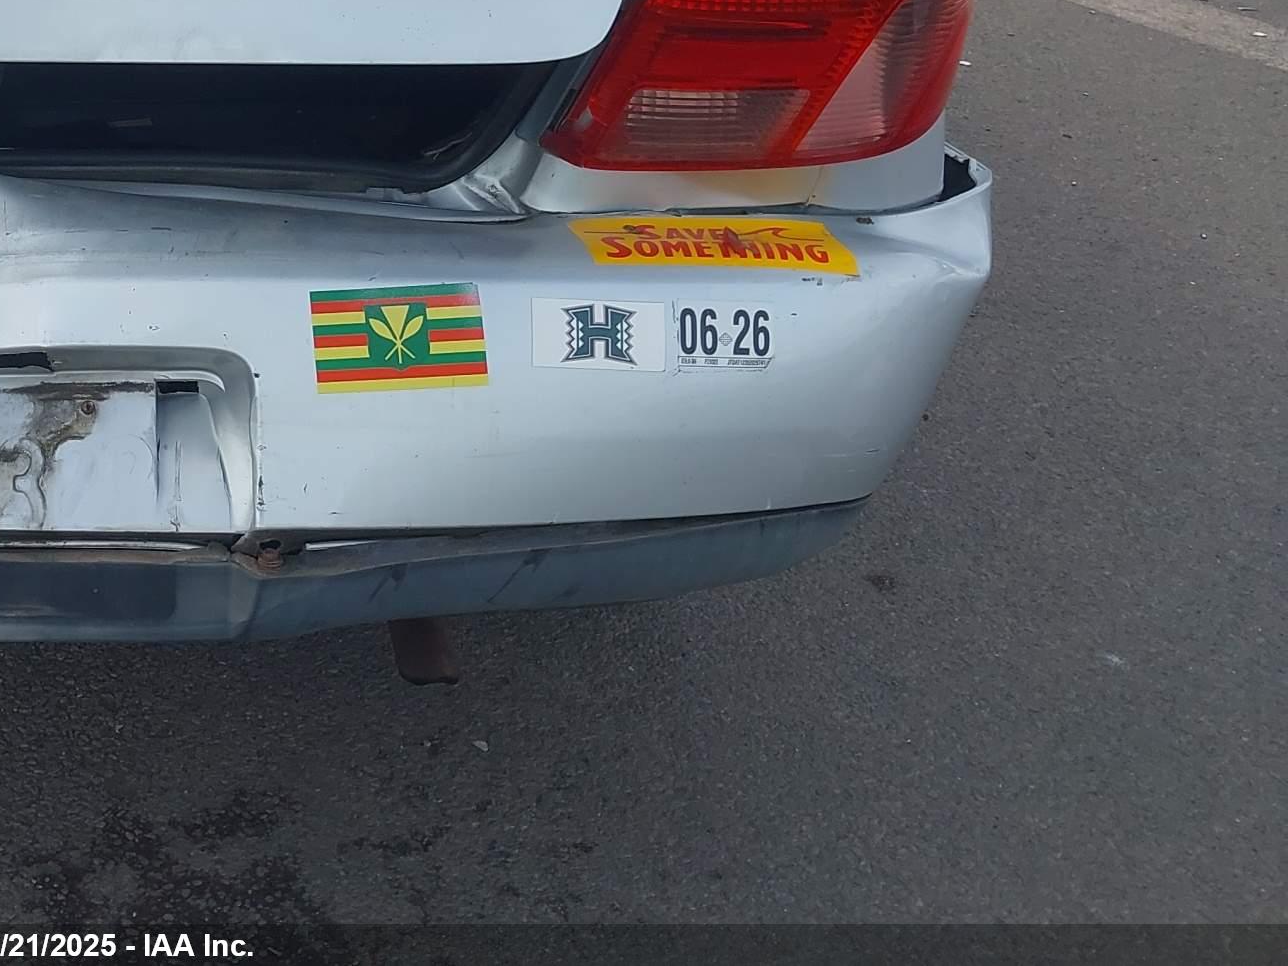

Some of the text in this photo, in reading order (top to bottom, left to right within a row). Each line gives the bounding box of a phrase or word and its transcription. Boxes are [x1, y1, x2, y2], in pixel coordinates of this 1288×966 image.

[634, 224, 731, 240] SAVE
[680, 308, 770, 356] 06 26
